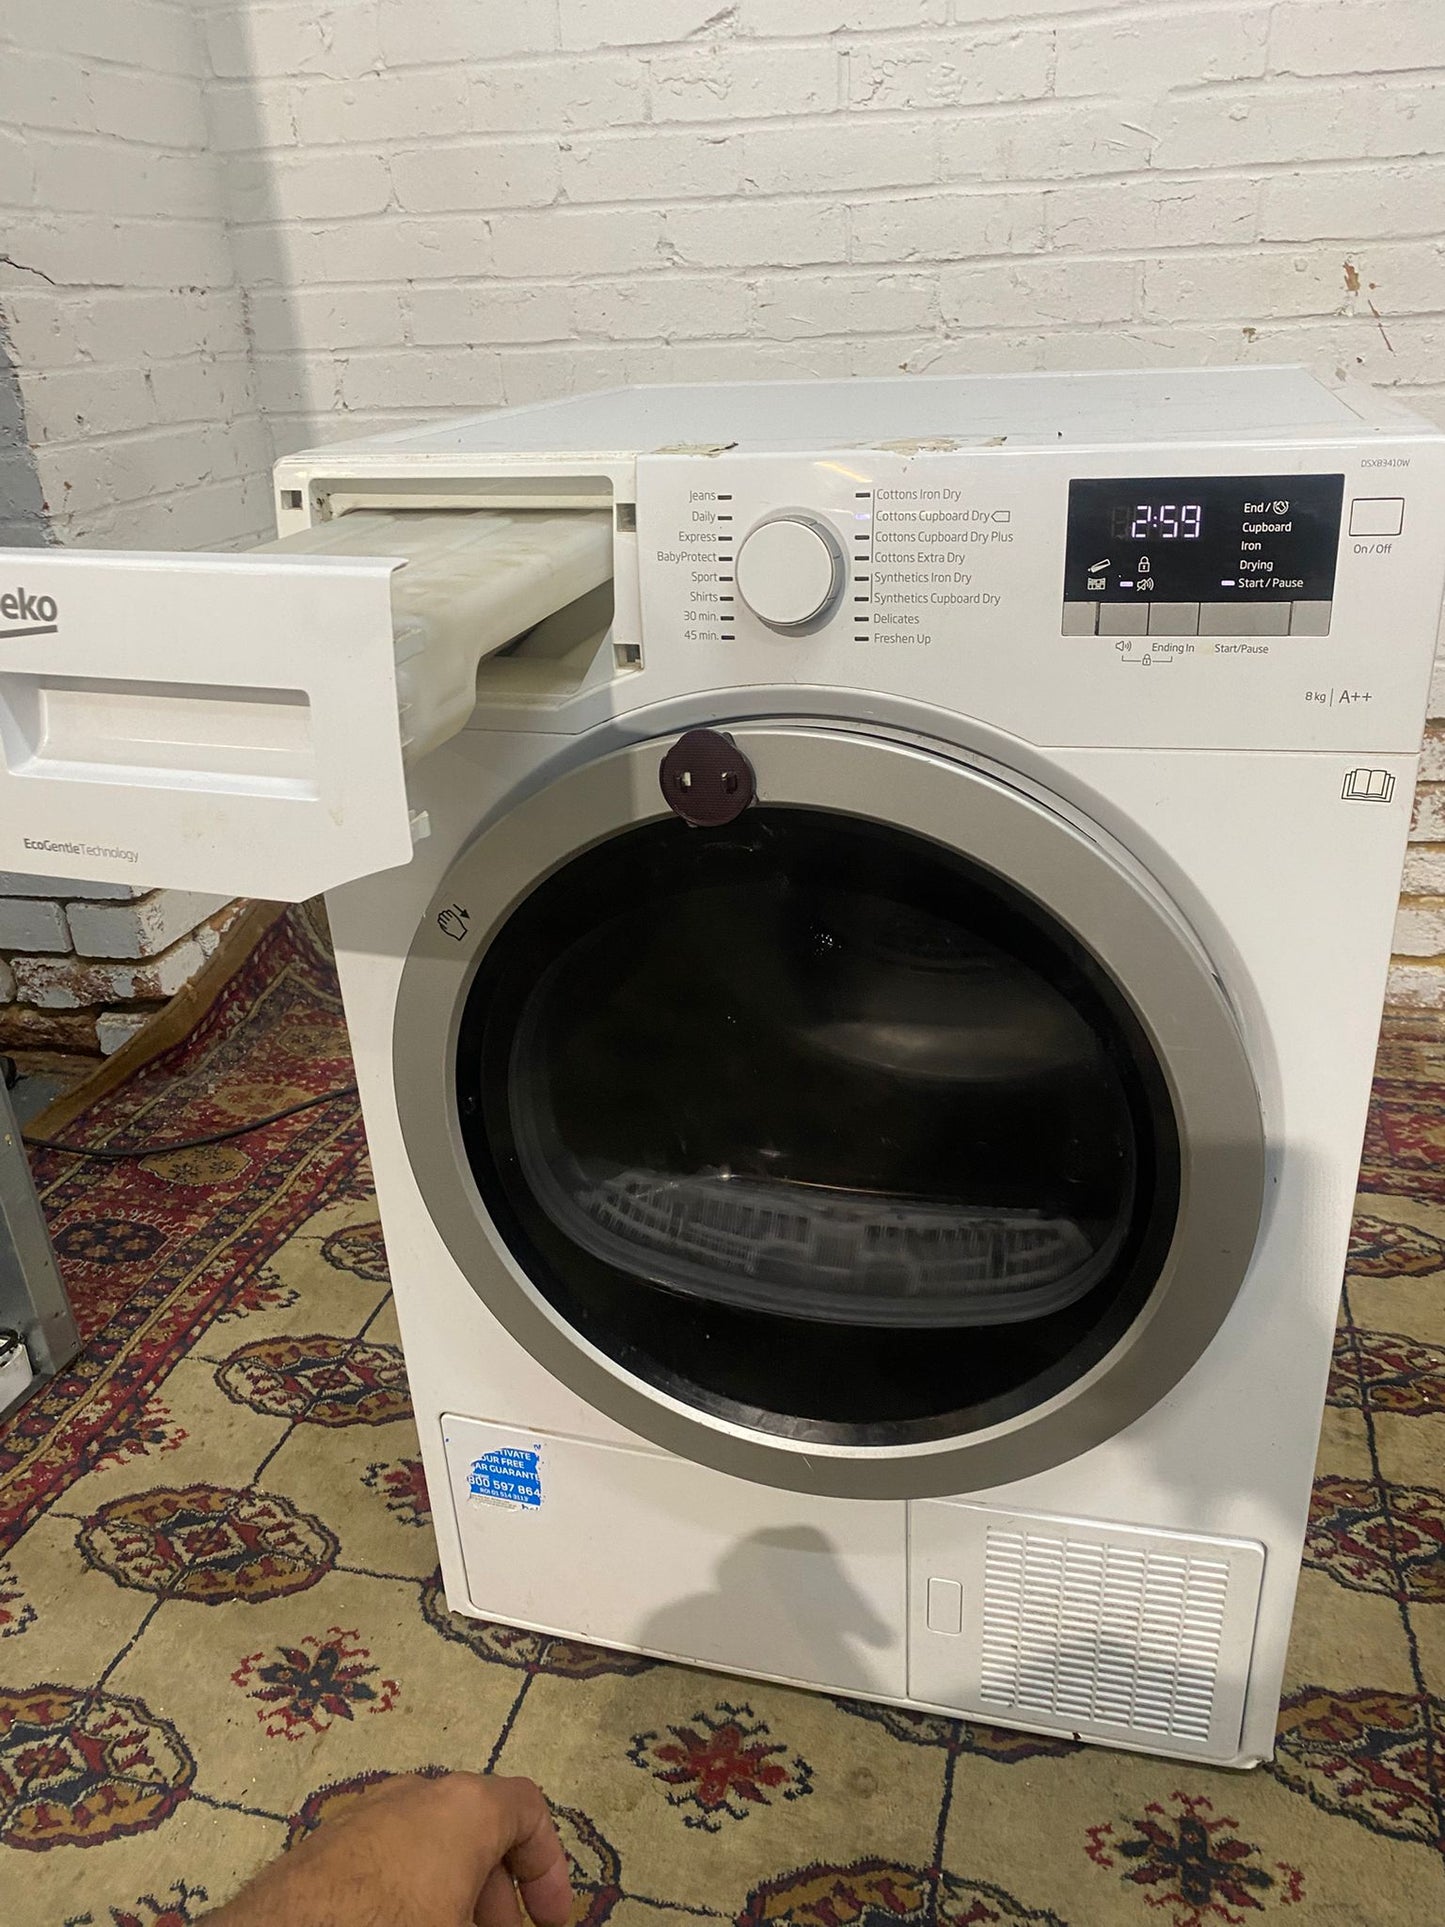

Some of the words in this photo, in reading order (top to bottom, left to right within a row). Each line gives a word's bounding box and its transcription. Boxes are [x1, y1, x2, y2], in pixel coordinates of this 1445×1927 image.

[689, 490, 716, 503] Jeans
[877, 489, 918, 500] Cottons
[920, 489, 940, 500] Iron
[943, 488, 961, 502] Dry
[1244, 502, 1264, 513] End
[692, 511, 716, 524] Daily
[876, 510, 916, 522] Cottons
[919, 510, 970, 523] Cupboard
[972, 510, 990, 524] Dry
[1132, 505, 1201, 538] 2:59
[1242, 522, 1292, 534] Cupboard
[679, 531, 716, 544] Express
[876, 531, 916, 542] Cottons
[918, 531, 968, 544] Cupboard
[970, 532, 989, 544] Dry
[991, 532, 1014, 542] Plus
[1241, 540, 1262, 550] Iron
[1354, 544, 1368, 554] On
[1376, 544, 1392, 554] Off
[657, 551, 717, 564] BabyProtect
[874, 552, 915, 562] Cottons
[918, 552, 944, 562] Extra
[947, 552, 965, 565] Dry
[1240, 560, 1274, 572] Drying
[692, 572, 718, 583] Sport
[874, 572, 929, 584] Synthetics
[931, 572, 952, 582] Iron
[954, 572, 972, 585] Dry
[1238, 578, 1264, 588] Start
[1272, 578, 1304, 588] Pause
[690, 591, 718, 602] Shirts
[874, 592, 928, 605] Synthetics
[930, 593, 980, 605] Cupboard
[982, 593, 1001, 606] Dry
[684, 610, 696, 620] 30
[699, 611, 718, 620] min.
[874, 613, 920, 624] Delicates
[684, 630, 697, 640] 45
[700, 630, 719, 640] min.
[874, 633, 914, 644] Freshen
[916, 634, 931, 645] Up
[1152, 642, 1184, 654] Ending
[1186, 644, 1194, 652] In
[1214, 644, 1269, 654] Start/Pause
[1305, 692, 1313, 700] 8
[1314, 692, 1326, 704] kg
[1338, 690, 1372, 704] A++
[24, 838, 139, 862] EcoGentleTechnology
[501, 1458, 524, 1468] FREE
[468, 1475, 490, 1487] 800
[493, 1480, 514, 1492] 597
[518, 1485, 541, 1498] 864
